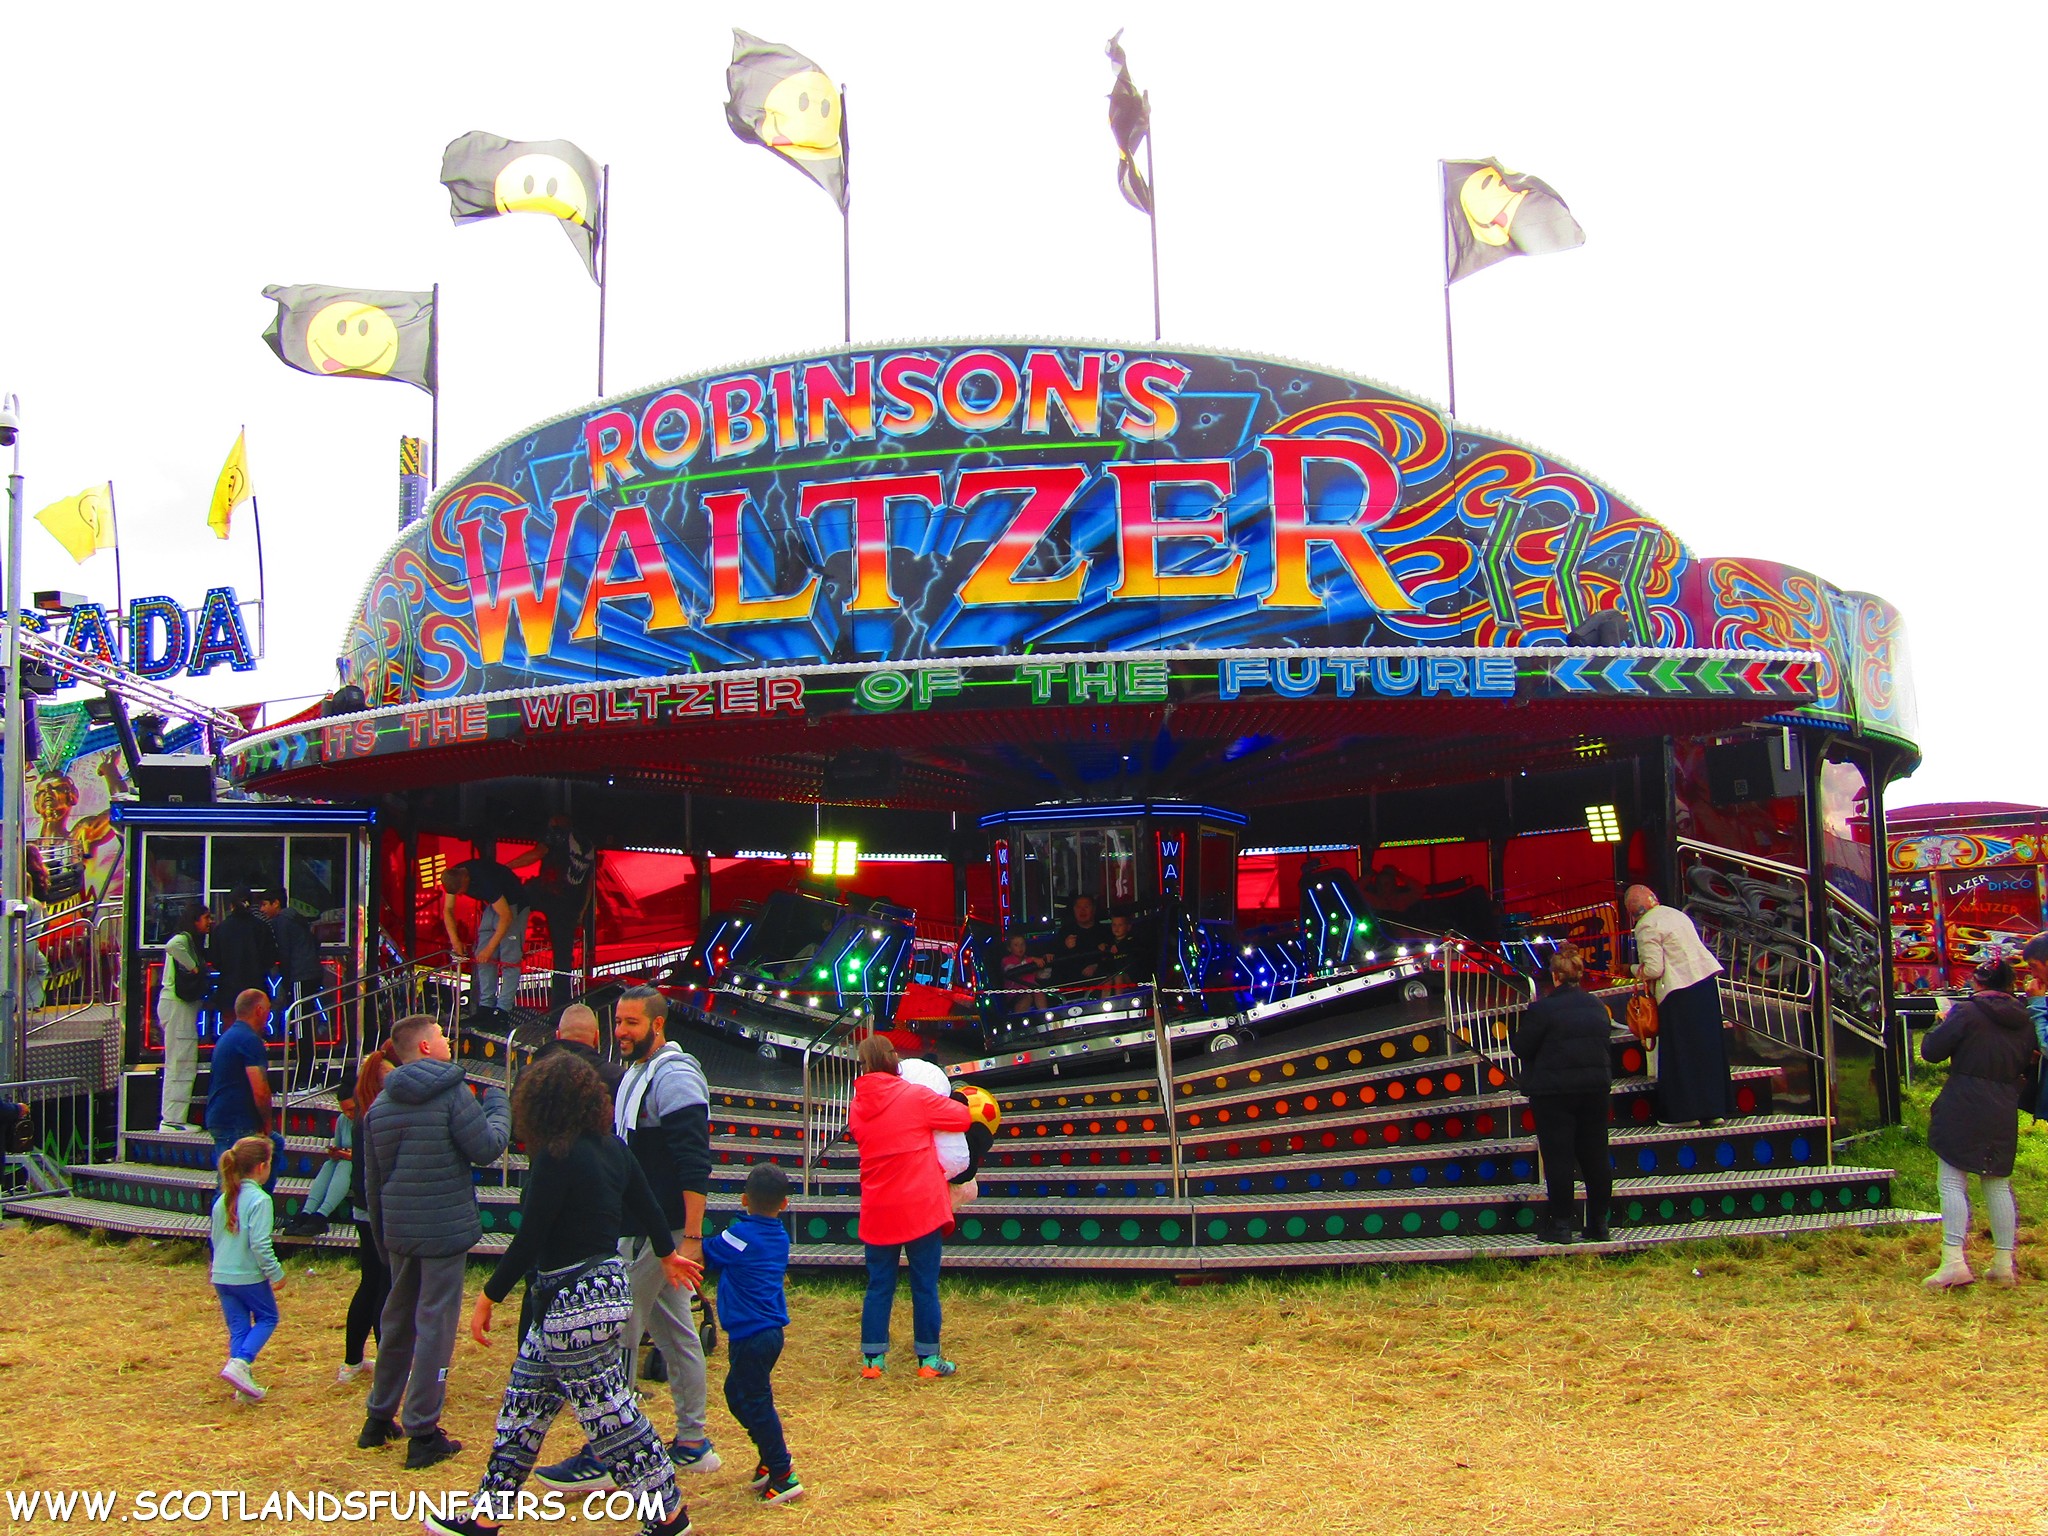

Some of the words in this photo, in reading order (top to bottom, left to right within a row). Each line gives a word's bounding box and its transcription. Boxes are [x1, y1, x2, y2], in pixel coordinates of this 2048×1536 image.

[583, 349, 1193, 492] ROBINSON'S
[456, 434, 1428, 667] WALTZER
[321, 719, 378, 760] ITS
[405, 704, 490, 748] THE
[519, 675, 806, 733] WALTZER
[855, 666, 962, 711] OF
[1015, 660, 1169, 704] THE
[1219, 656, 1518, 700] FUTURE
[1948, 874, 1989, 895] LAZER
[1988, 879, 2032, 892] DISCO
[1960, 902, 2018, 914] WALTZER
